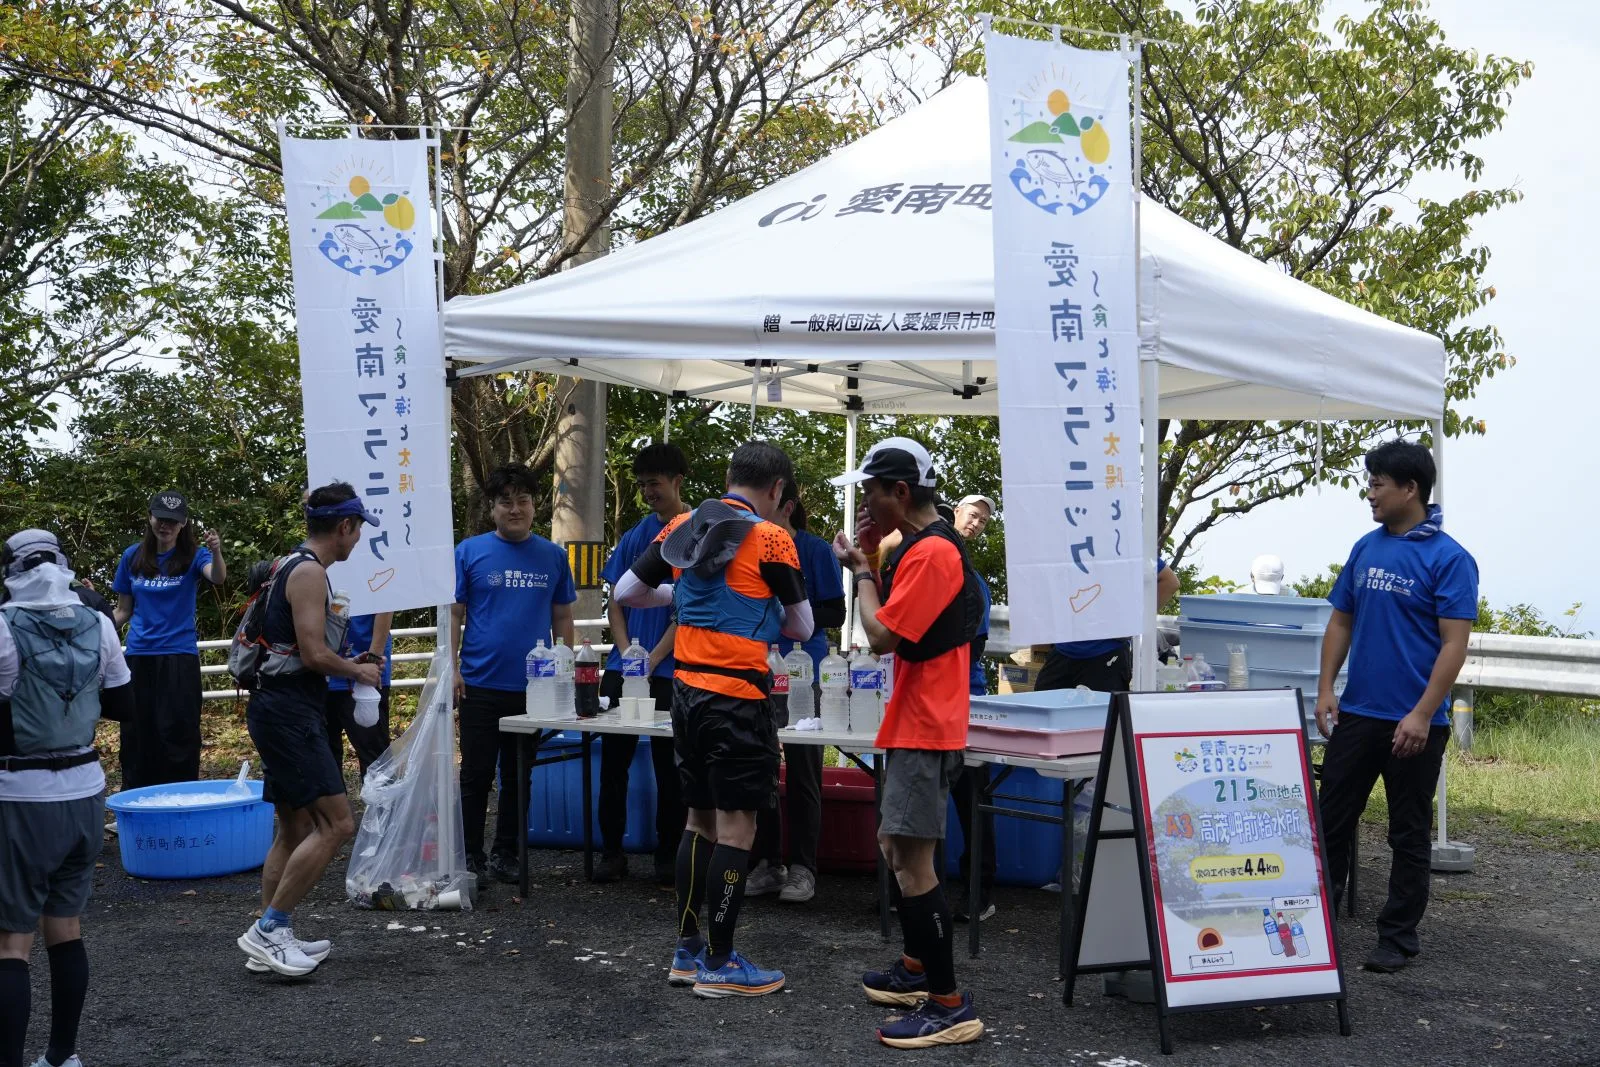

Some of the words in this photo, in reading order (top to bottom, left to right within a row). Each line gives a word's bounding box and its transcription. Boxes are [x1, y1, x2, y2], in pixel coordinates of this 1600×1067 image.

[763, 313, 781, 333] 贈
[504, 569, 549, 580] 愛南マラニック
[1368, 567, 1415, 587] 愛南マラニック
[144, 579, 168, 587] 2026
[505, 579, 534, 588] 2026
[1366, 578, 1393, 591] 2026
[1200, 739, 1271, 756] 愛南マラニック
[1203, 756, 1248, 773] 2026
[1198, 807, 1301, 845] 高茂岬前給水所
[1201, 956, 1225, 964] まんじゅう
[701, 972, 727, 983] HOKA
